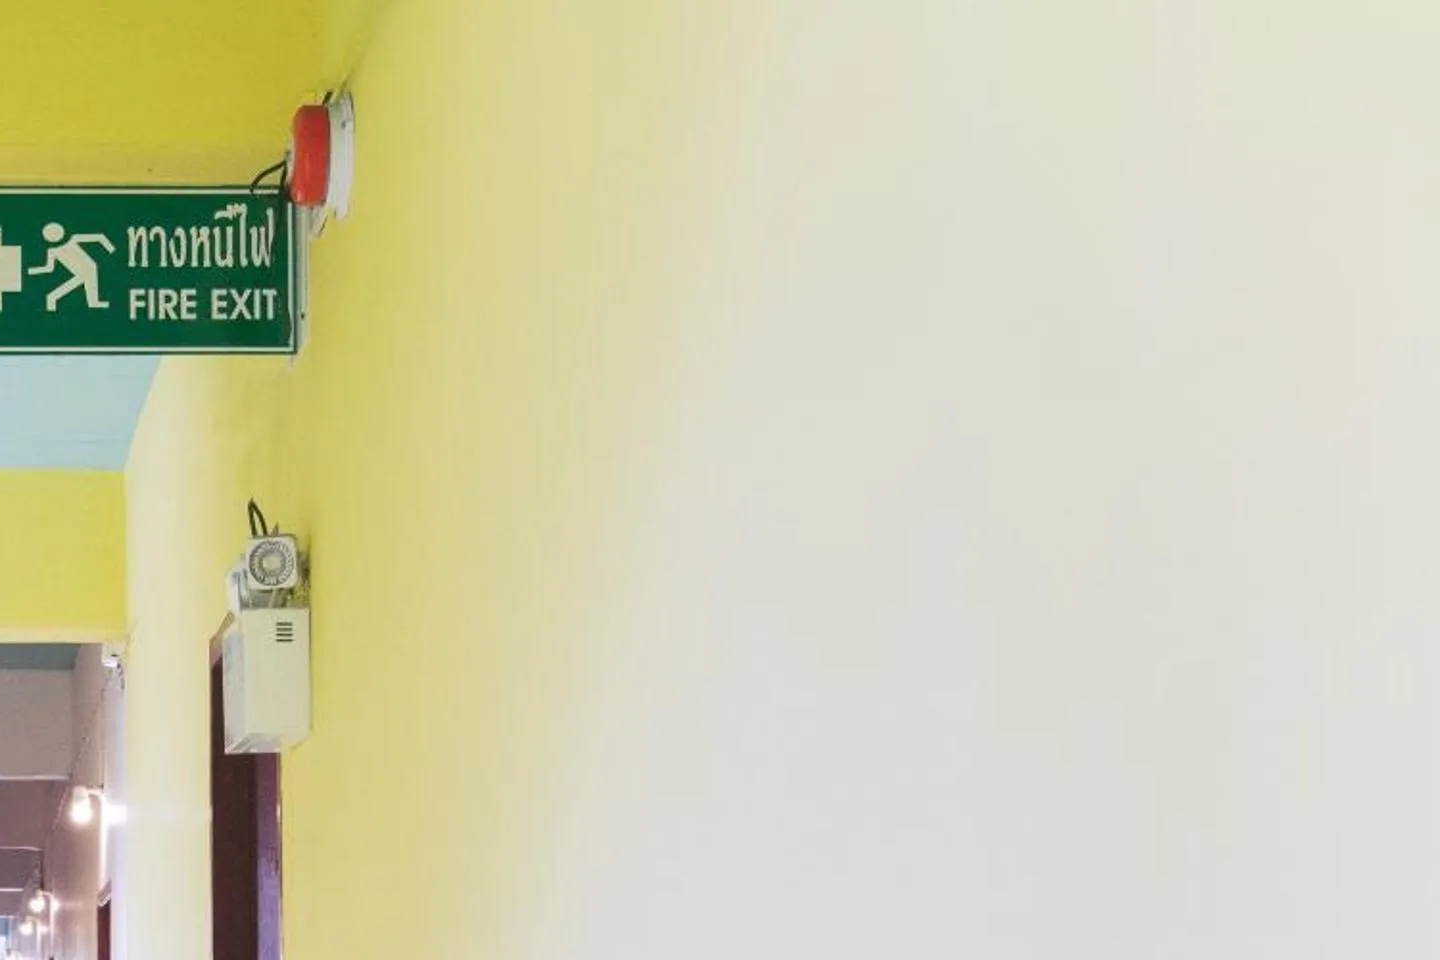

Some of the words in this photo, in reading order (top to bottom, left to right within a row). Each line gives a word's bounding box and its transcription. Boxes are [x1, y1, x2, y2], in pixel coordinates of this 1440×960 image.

[127, 203, 275, 268] ทางหนีไฟ
[129, 288, 197, 320] FIRE
[211, 288, 277, 320] EXIT
